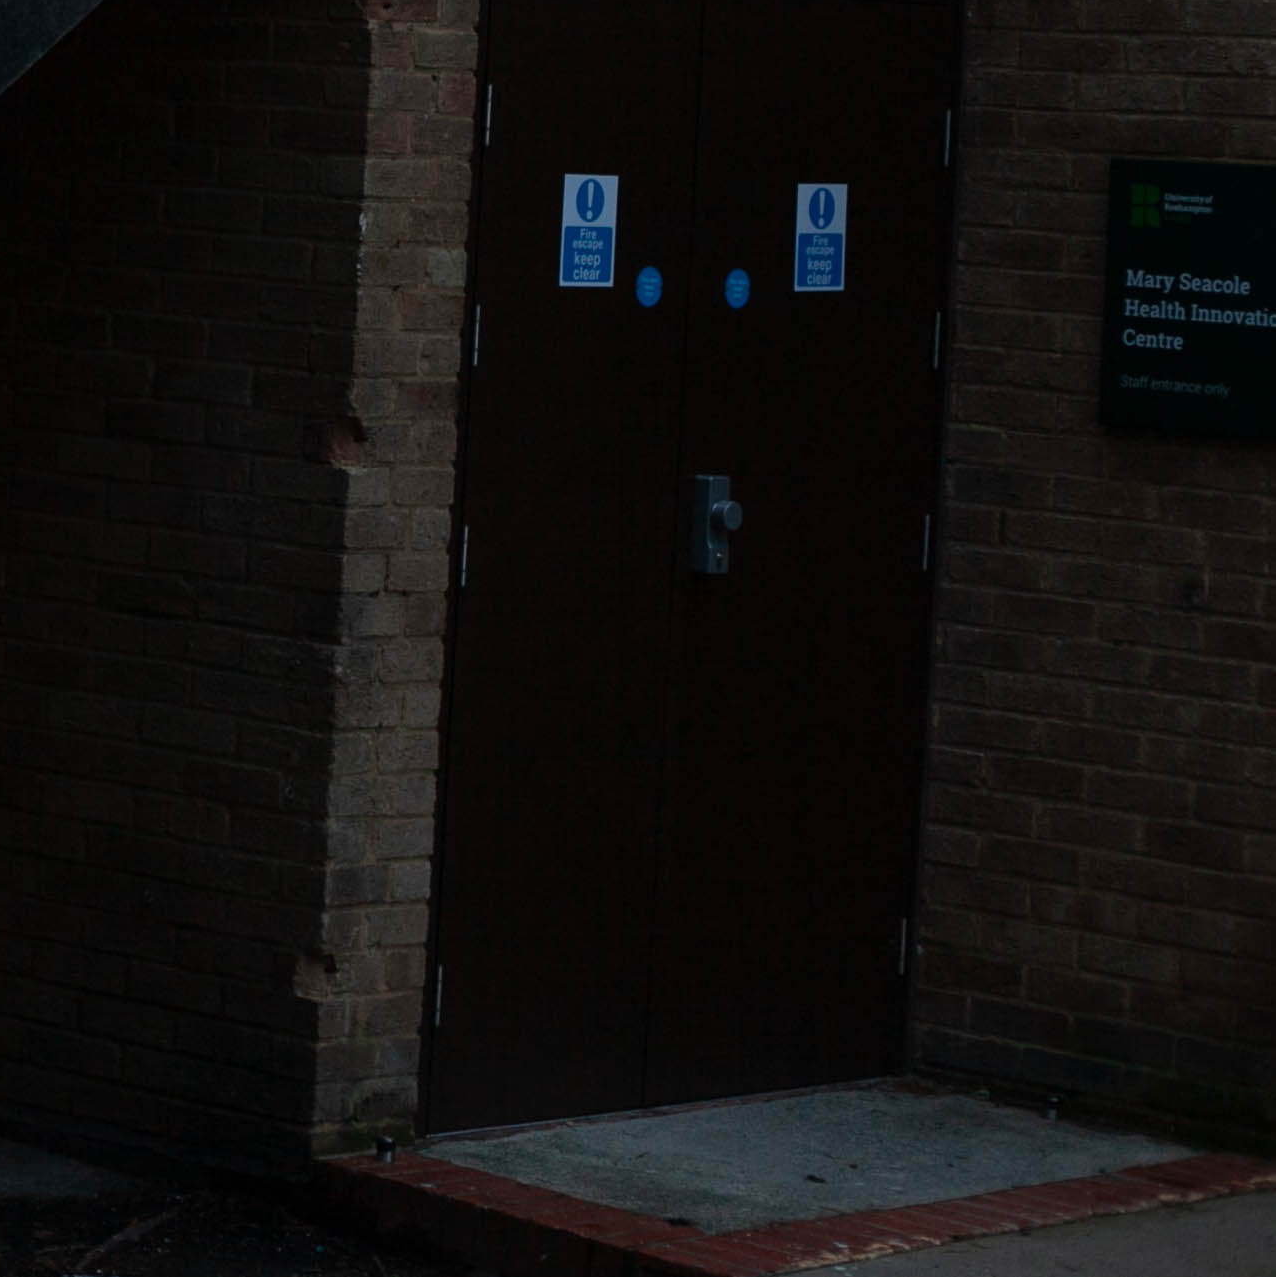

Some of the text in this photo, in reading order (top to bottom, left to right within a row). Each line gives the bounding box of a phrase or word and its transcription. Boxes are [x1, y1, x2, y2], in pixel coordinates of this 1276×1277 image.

[579, 228, 598, 240] Fire
[574, 251, 601, 269] keep
[573, 266, 601, 281] clear
[1126, 269, 1252, 296] Mary Seacole
[1124, 299, 1187, 321] Health
[1123, 328, 1184, 351] Centre
[1119, 374, 1230, 399] Staff entrance only
